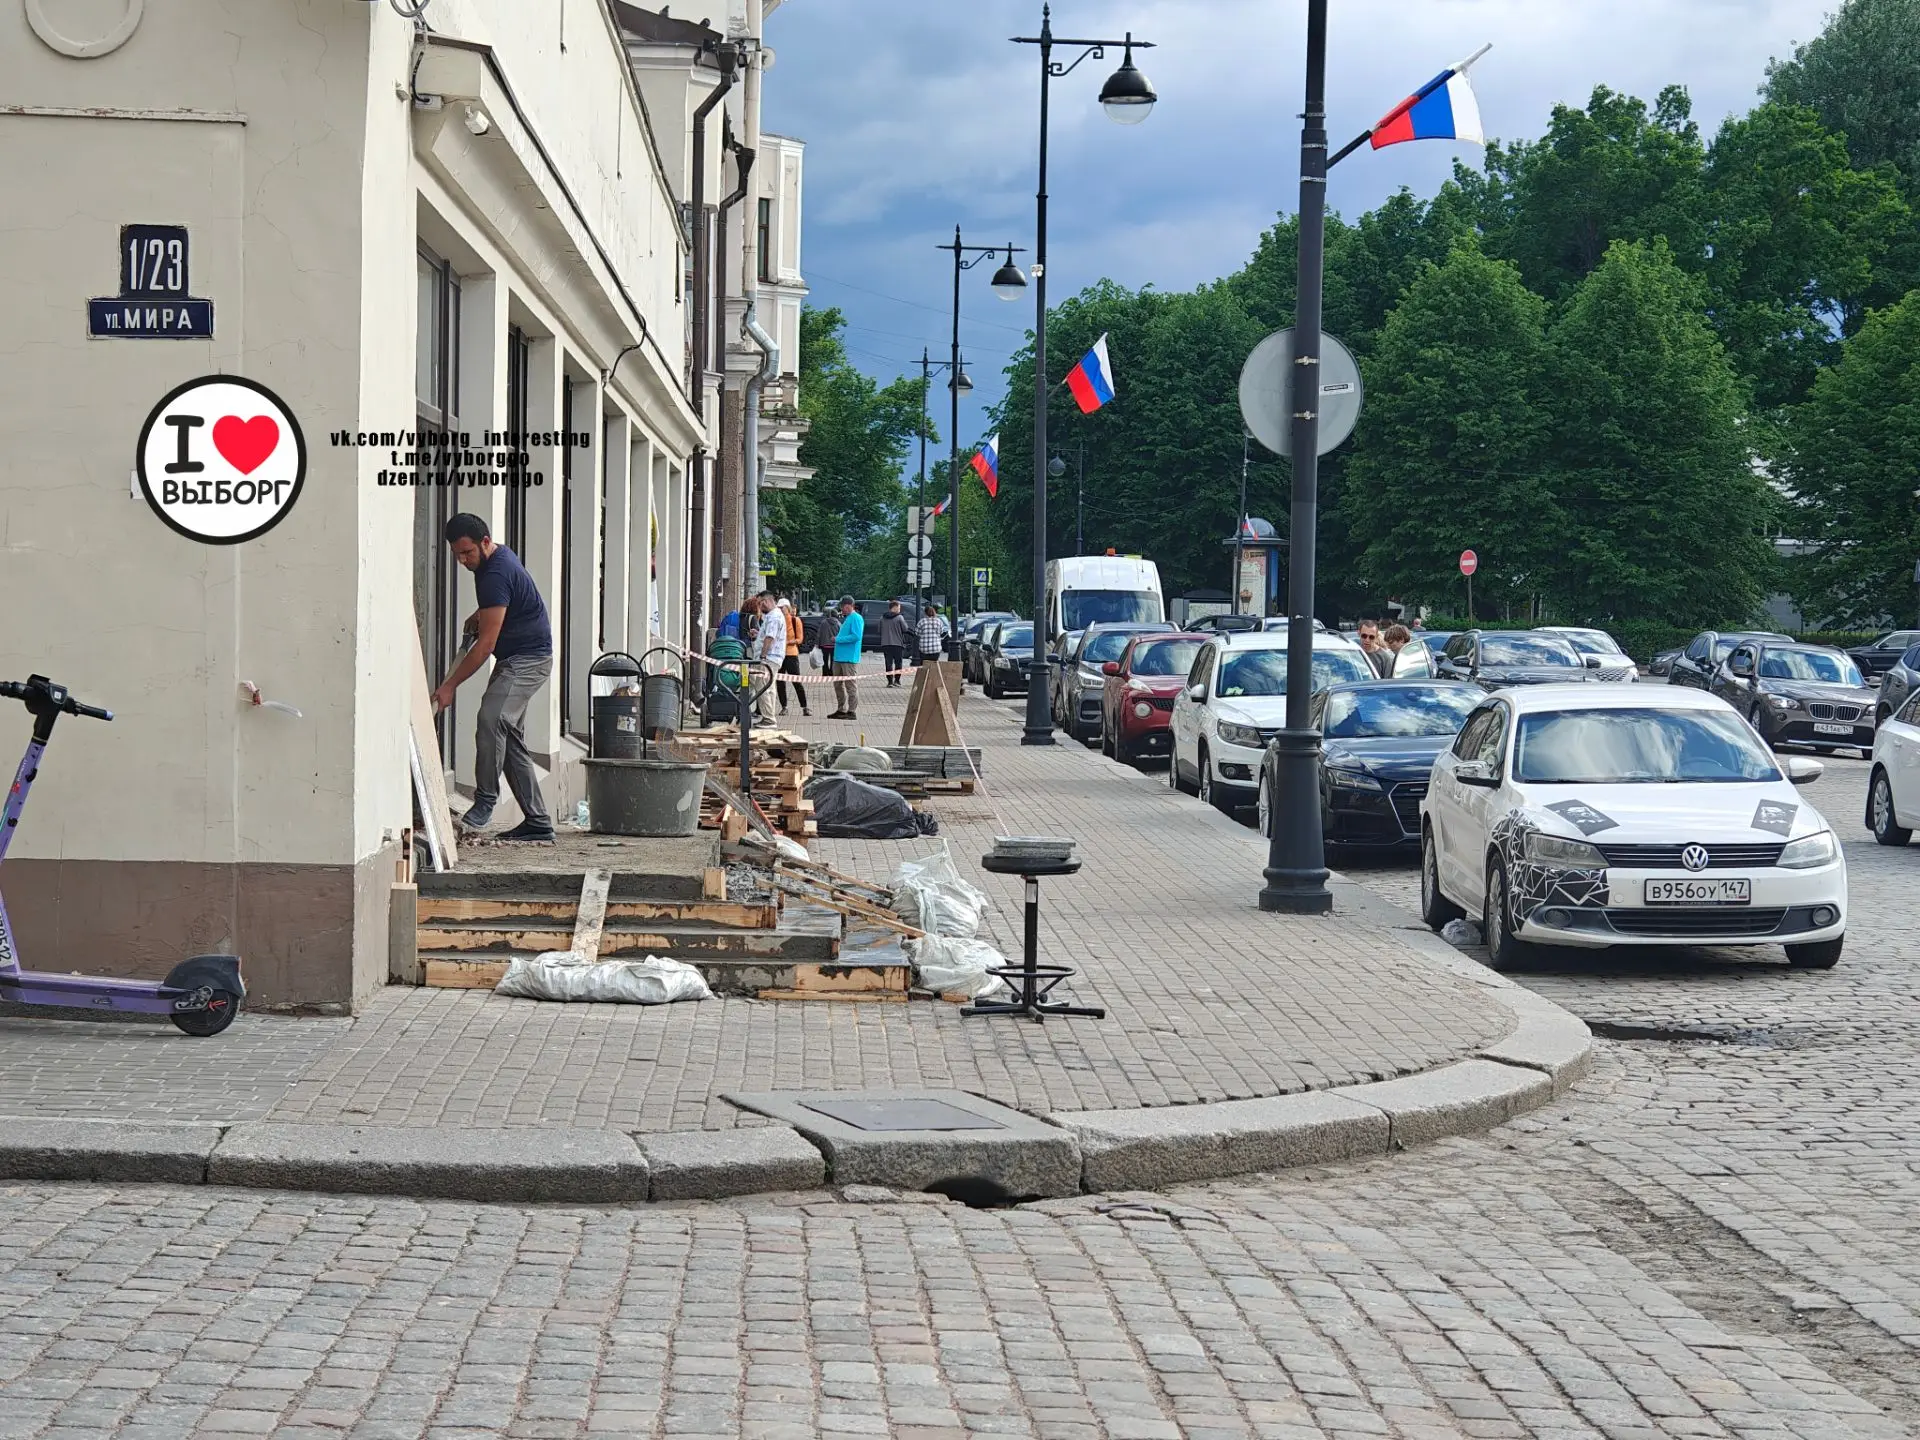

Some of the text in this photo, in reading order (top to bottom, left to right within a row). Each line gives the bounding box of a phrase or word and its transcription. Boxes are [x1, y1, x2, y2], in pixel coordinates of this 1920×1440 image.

[130, 239, 183, 290] 1/23
[105, 308, 192, 329] ул. МИРА
